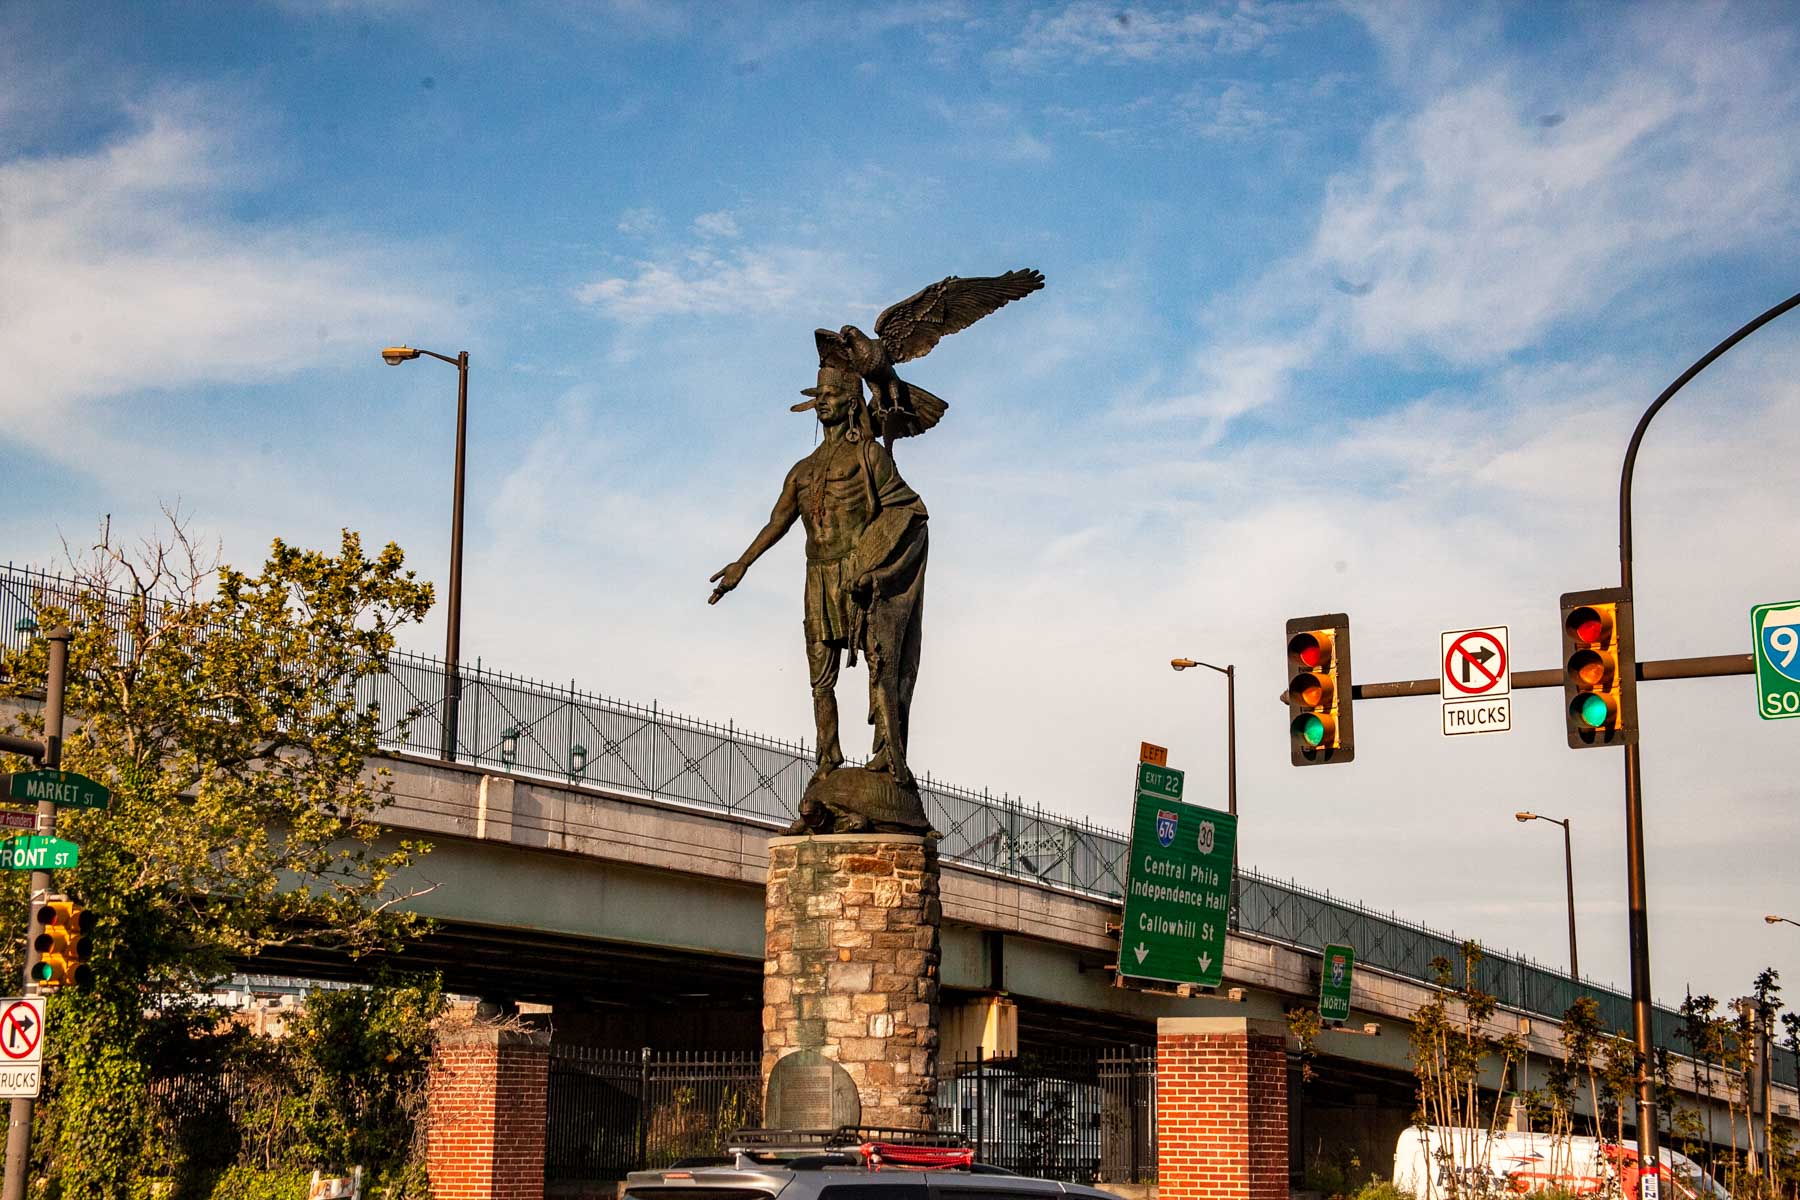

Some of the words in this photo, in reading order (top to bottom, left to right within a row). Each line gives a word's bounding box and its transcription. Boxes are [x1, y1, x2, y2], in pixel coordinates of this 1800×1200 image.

[1767, 691, 1800, 714] SO
[1447, 706, 1506, 727] TRUCKS
[1143, 744, 1165, 761] LEFT
[26, 780, 79, 802] MARKET
[83, 793, 95, 806] ST
[1145, 771, 1162, 785] EXIT
[1165, 775, 1179, 793] 22
[1159, 821, 1174, 840] 676
[1199, 827, 1213, 848] 30
[54, 853, 69, 866] ST
[1144, 855, 1186, 880] Central
[1191, 865, 1219, 887] Phila
[1131, 877, 1203, 907] Independence
[1205, 891, 1227, 911] Hall
[1140, 912, 1196, 939] Callowhill
[1201, 922, 1214, 942] St
[1333, 963, 1344, 978] 95
[1323, 997, 1347, 1012] NORTH
[0, 1072, 36, 1088] RUCKS
